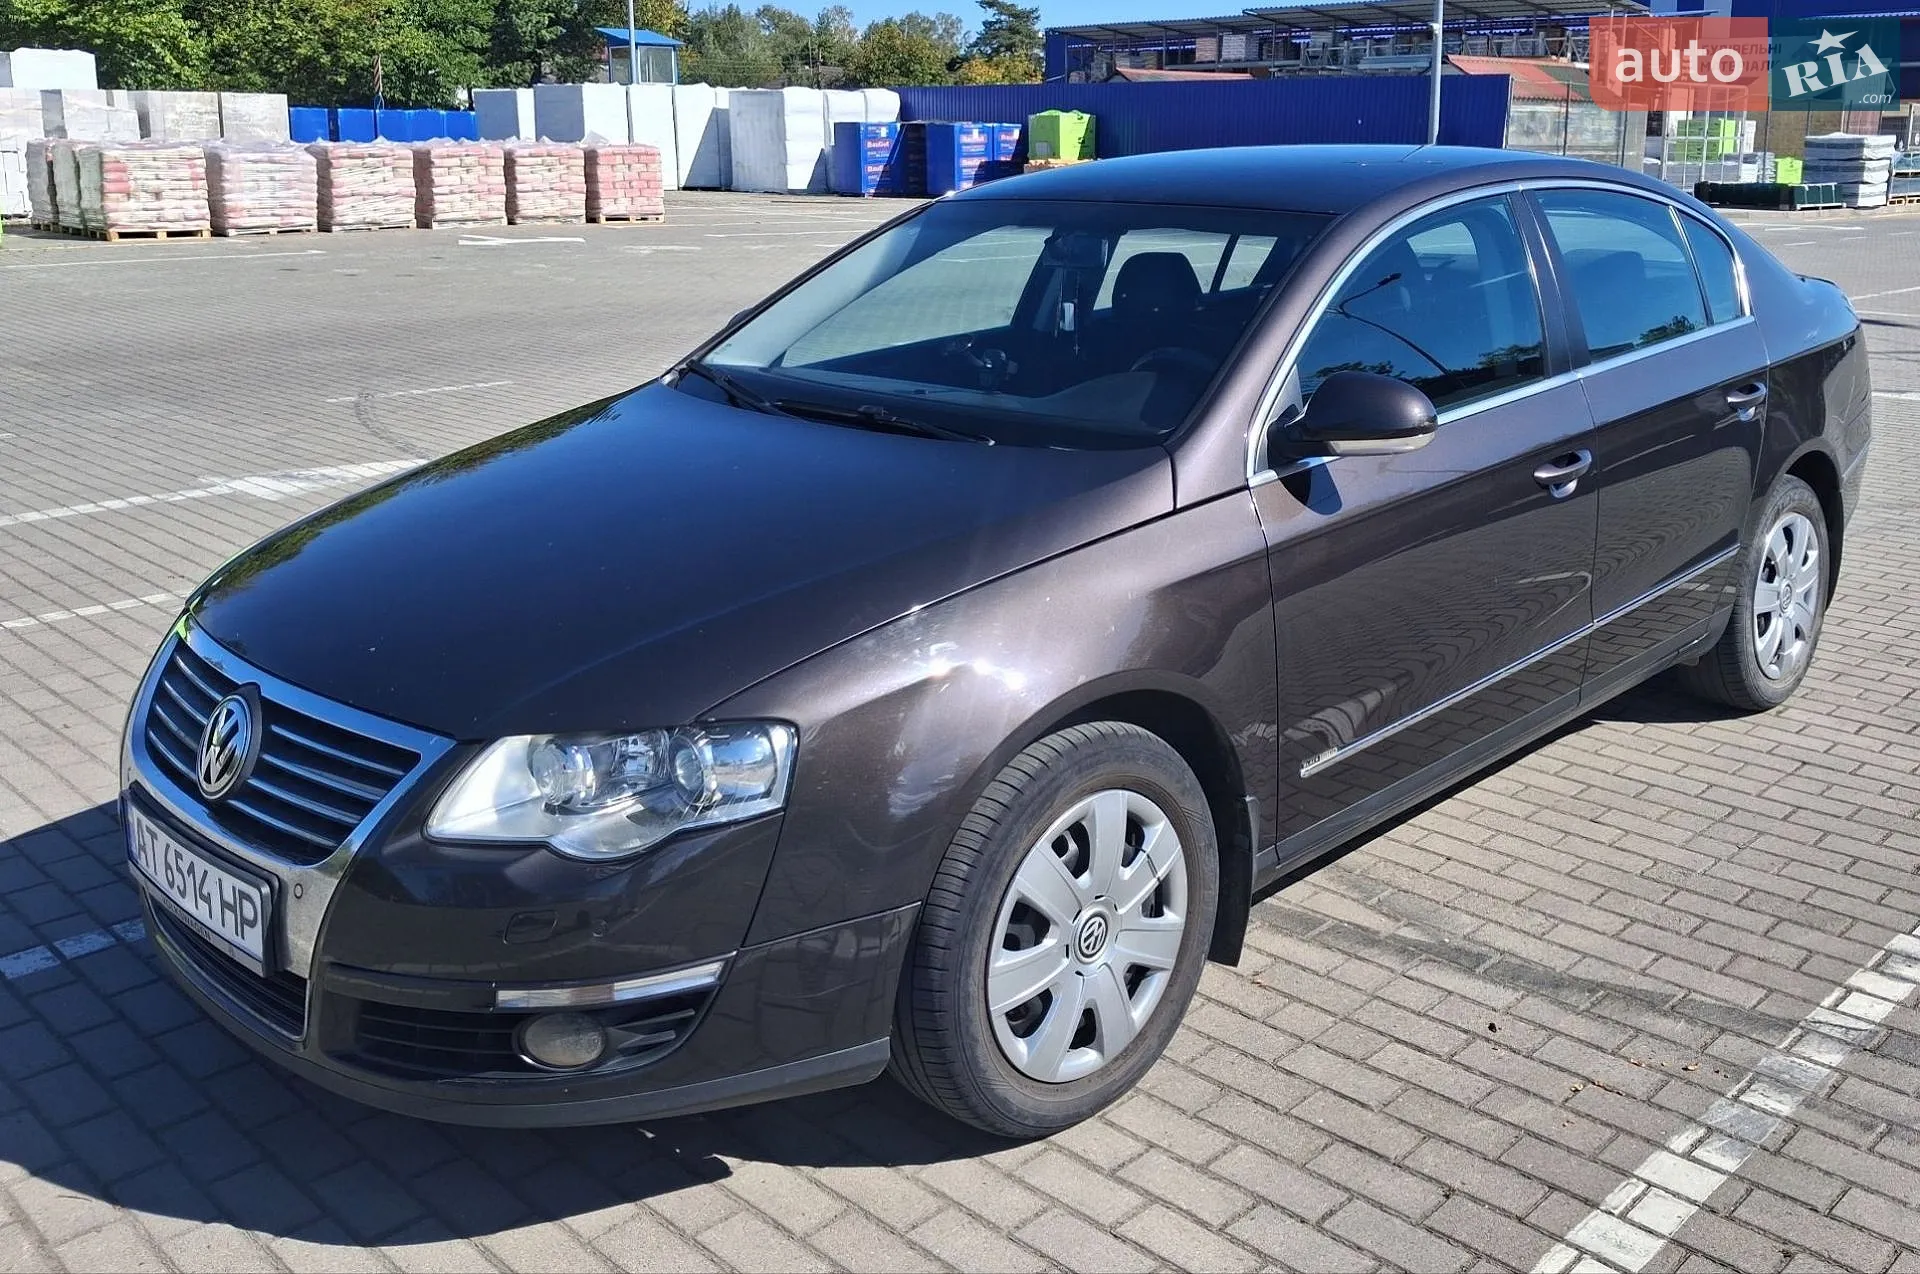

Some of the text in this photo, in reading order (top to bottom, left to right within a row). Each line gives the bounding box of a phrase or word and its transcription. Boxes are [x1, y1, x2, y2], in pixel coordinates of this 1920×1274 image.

[1700, 60, 1780, 74] МТЕІАЛИ
[136, 817, 259, 940] AT 6514 HP
